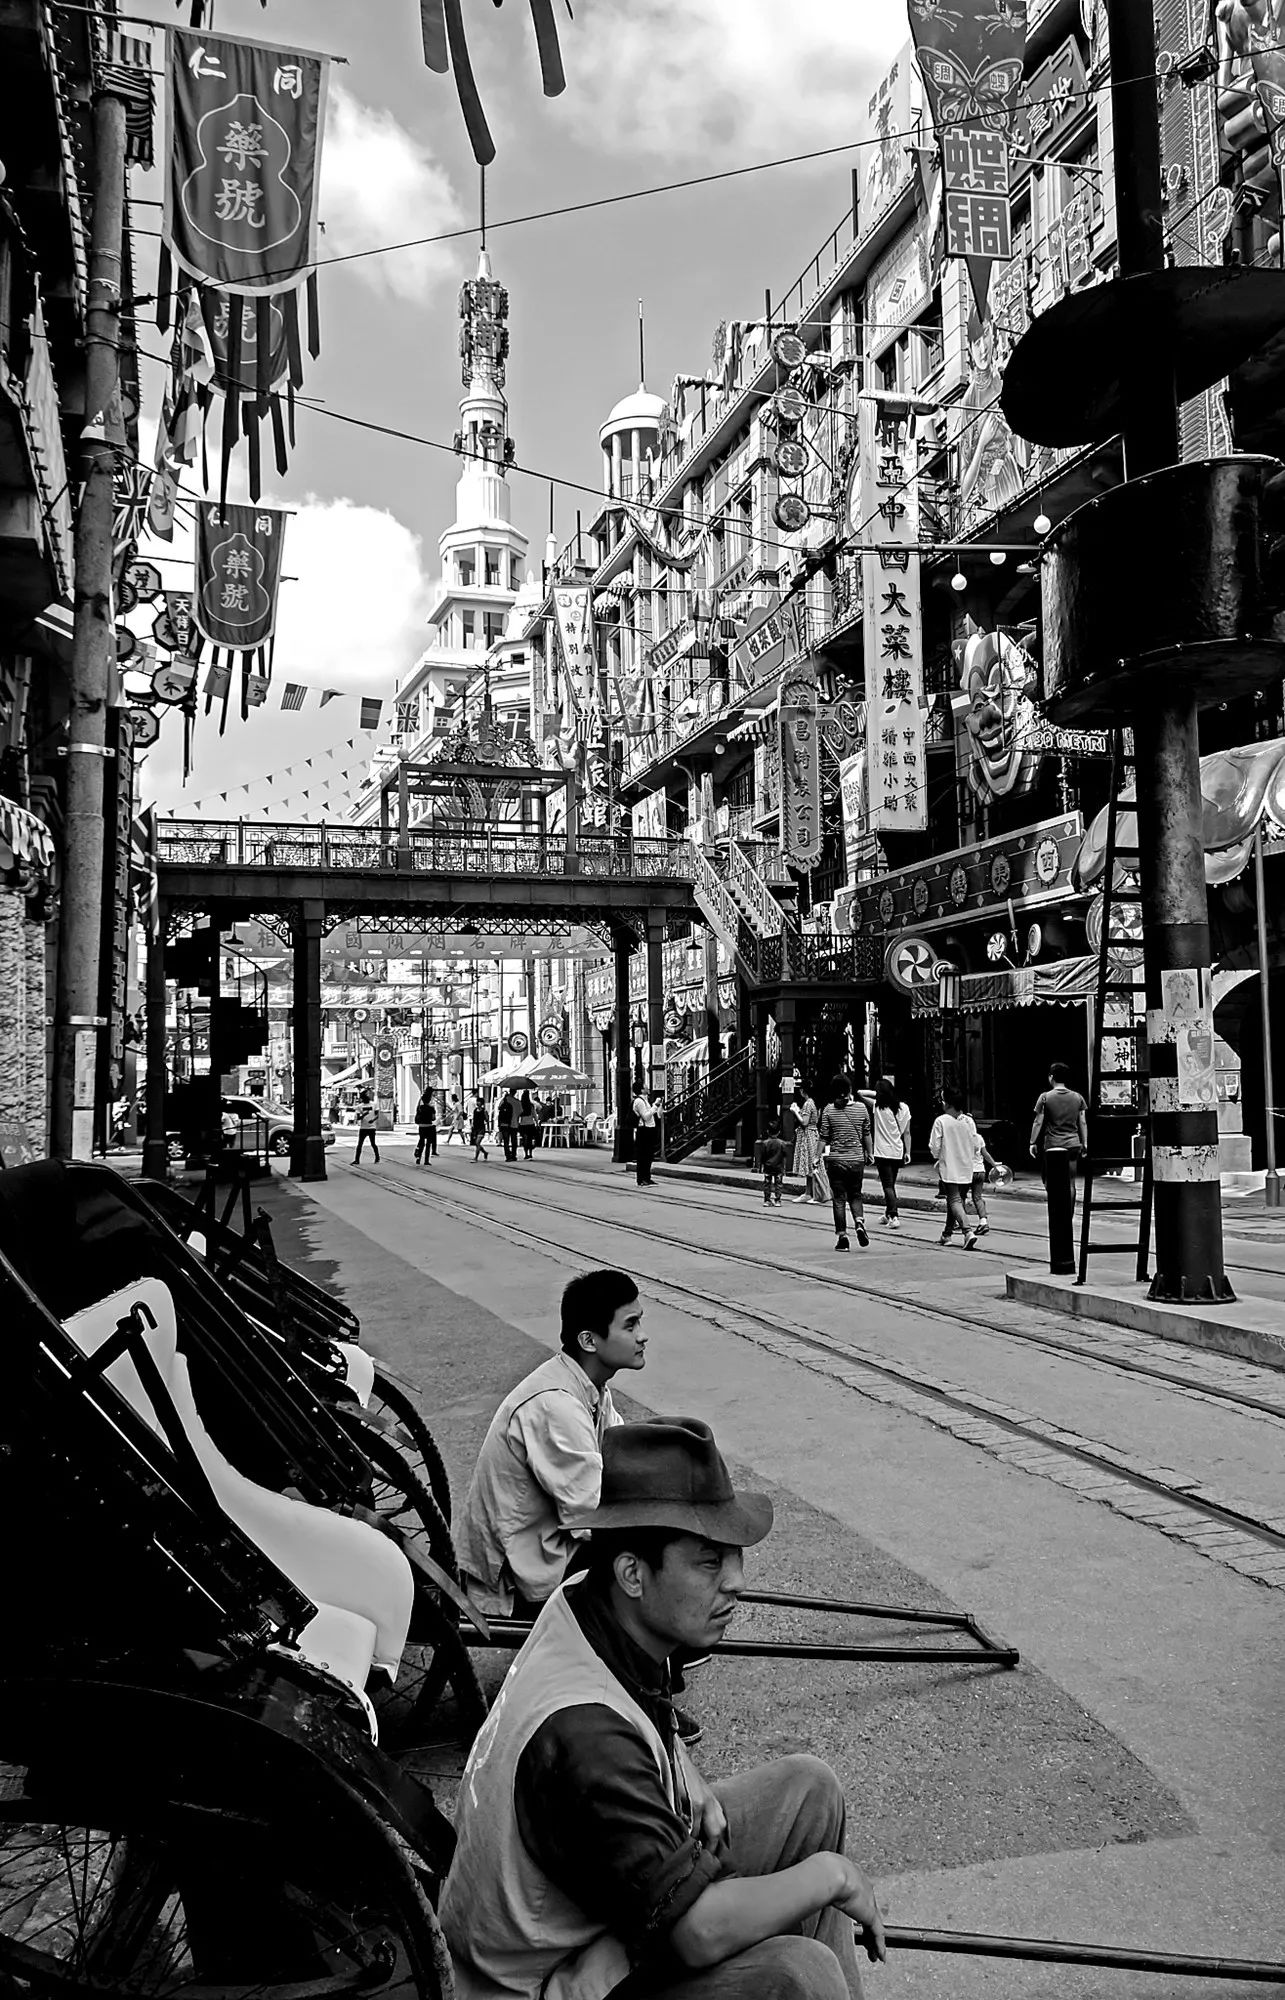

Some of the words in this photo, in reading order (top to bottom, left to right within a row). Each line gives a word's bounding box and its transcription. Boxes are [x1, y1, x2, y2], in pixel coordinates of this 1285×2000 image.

[214, 120, 269, 229] 藥號
[220, 548, 253, 612] 藥號
[875, 424, 913, 705] 亞中西大菜樓
[902, 726, 918, 812] 中西大菜
